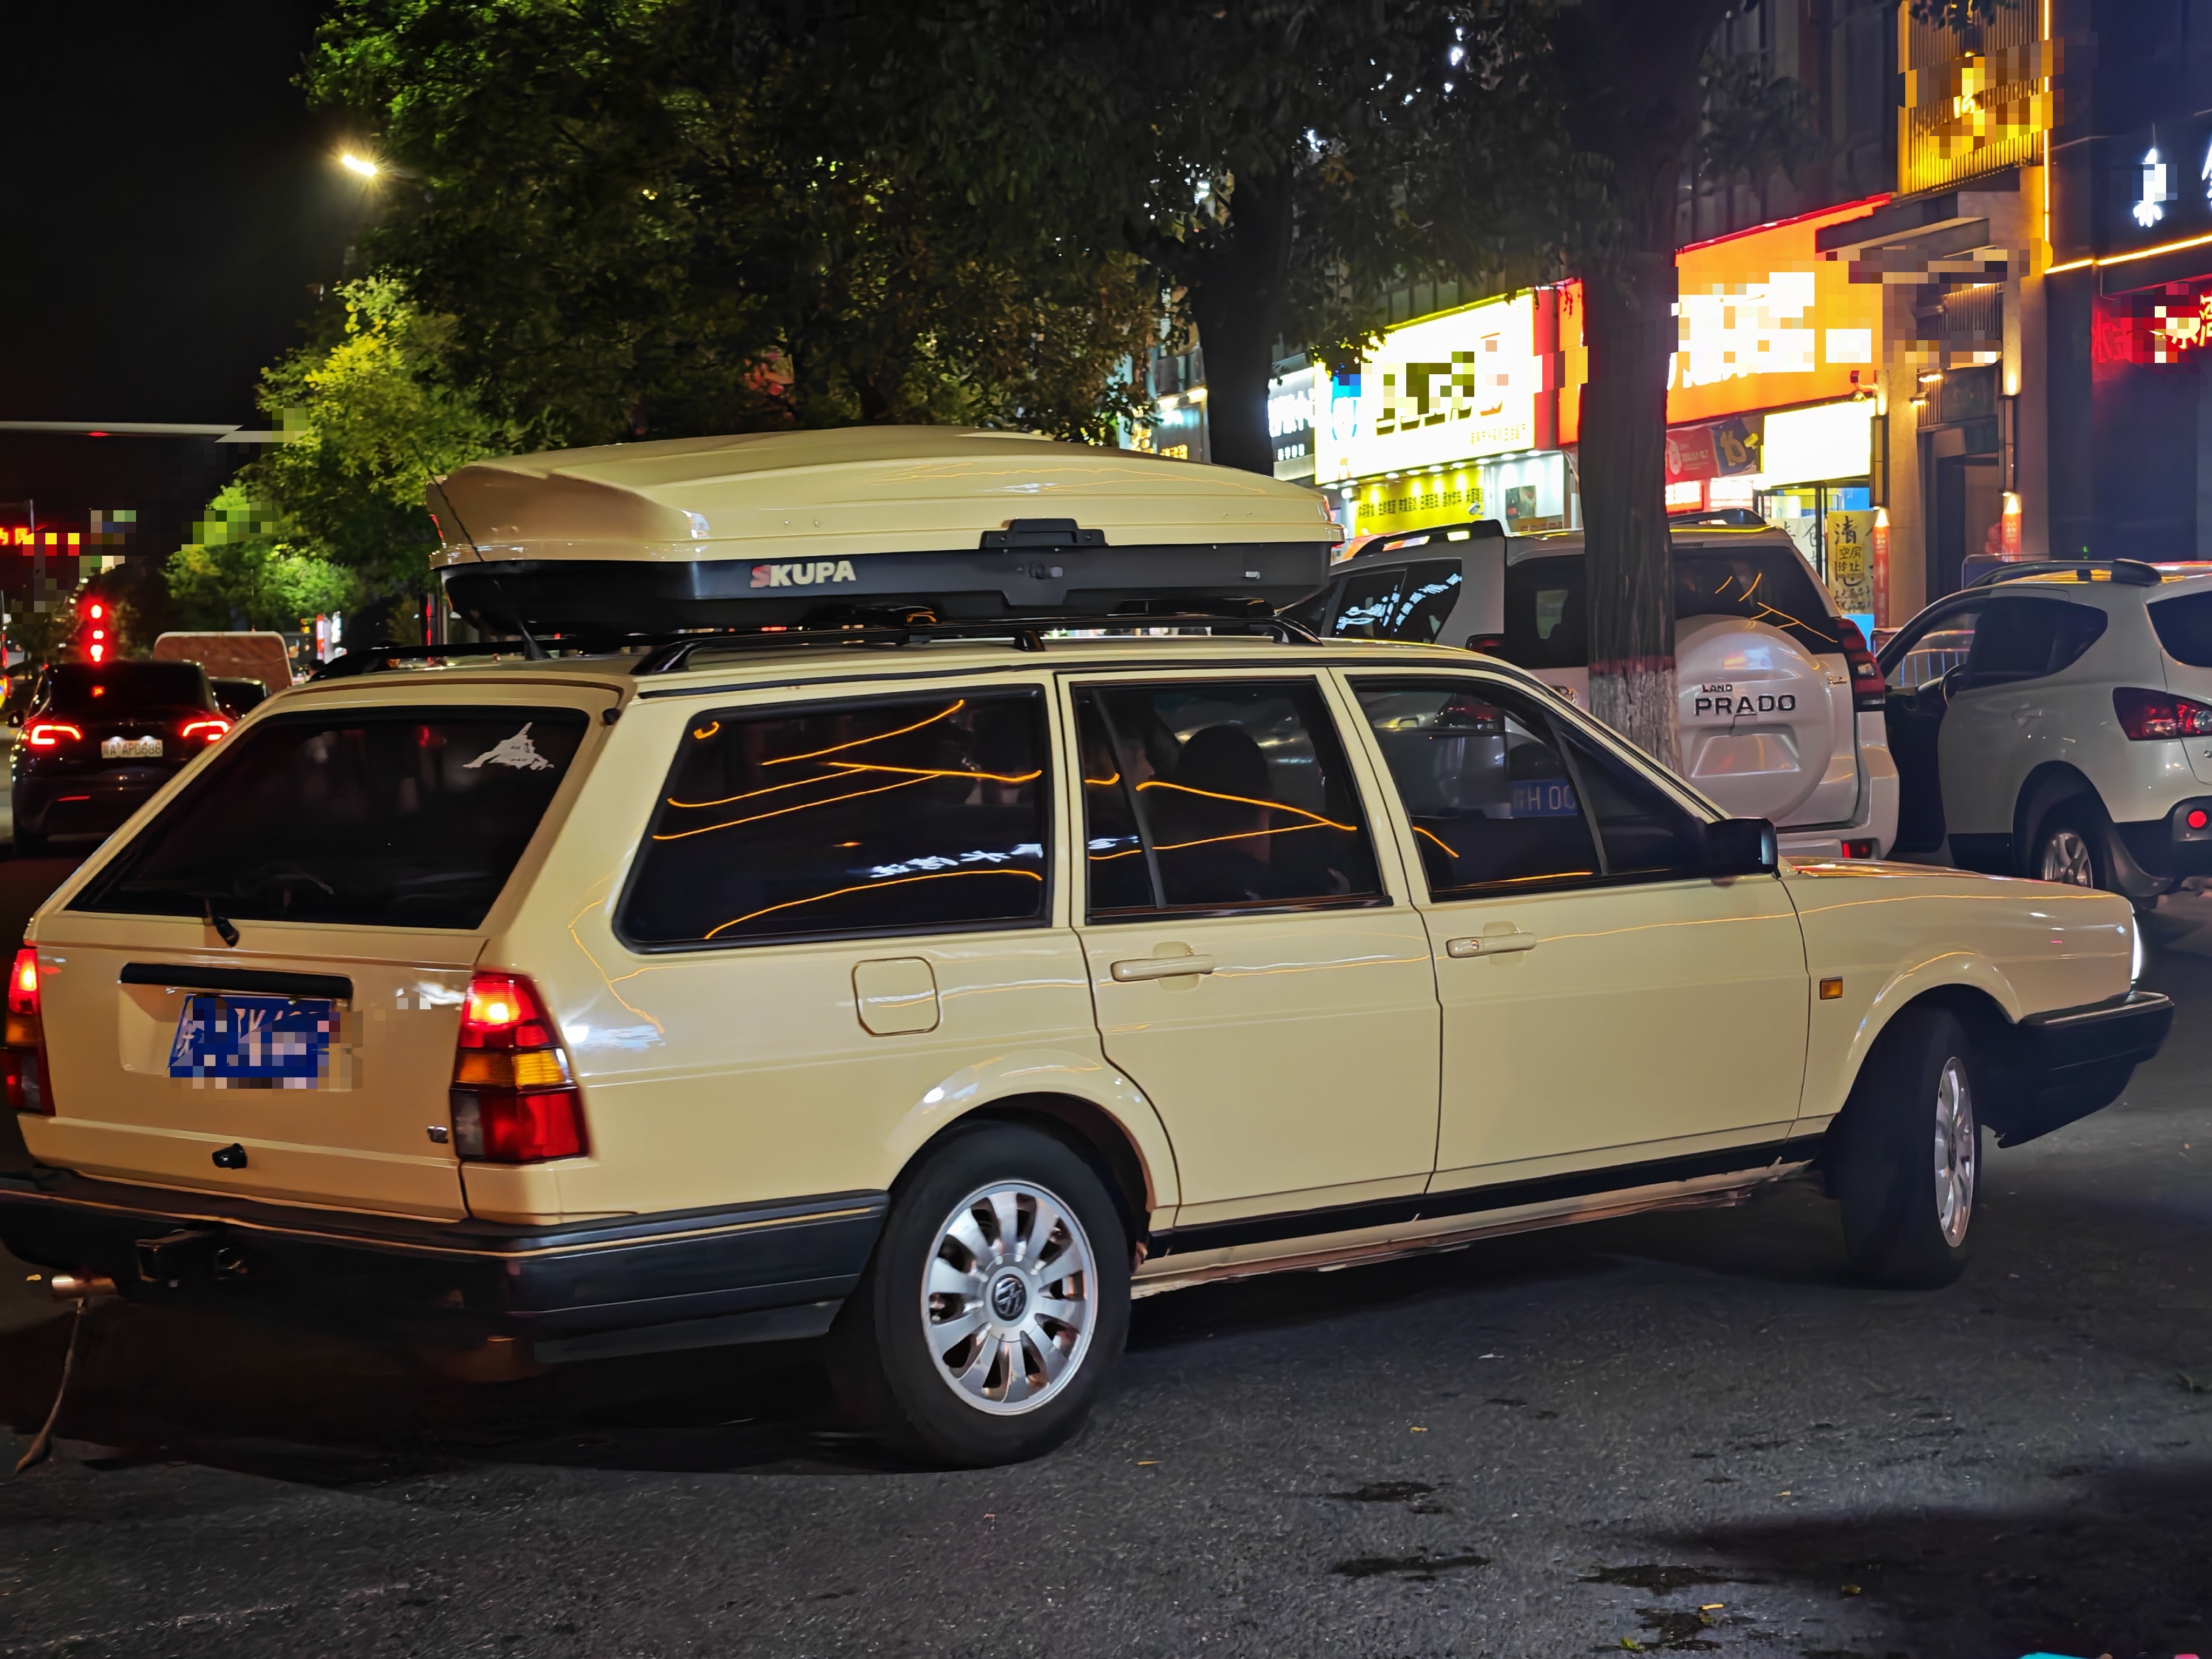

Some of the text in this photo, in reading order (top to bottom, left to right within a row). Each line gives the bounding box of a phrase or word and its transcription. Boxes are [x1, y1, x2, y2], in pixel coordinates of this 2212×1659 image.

[750, 560, 857, 588] SKUPA
[1702, 684, 1733, 693] LAND
[1694, 693, 1796, 716] PRADO
